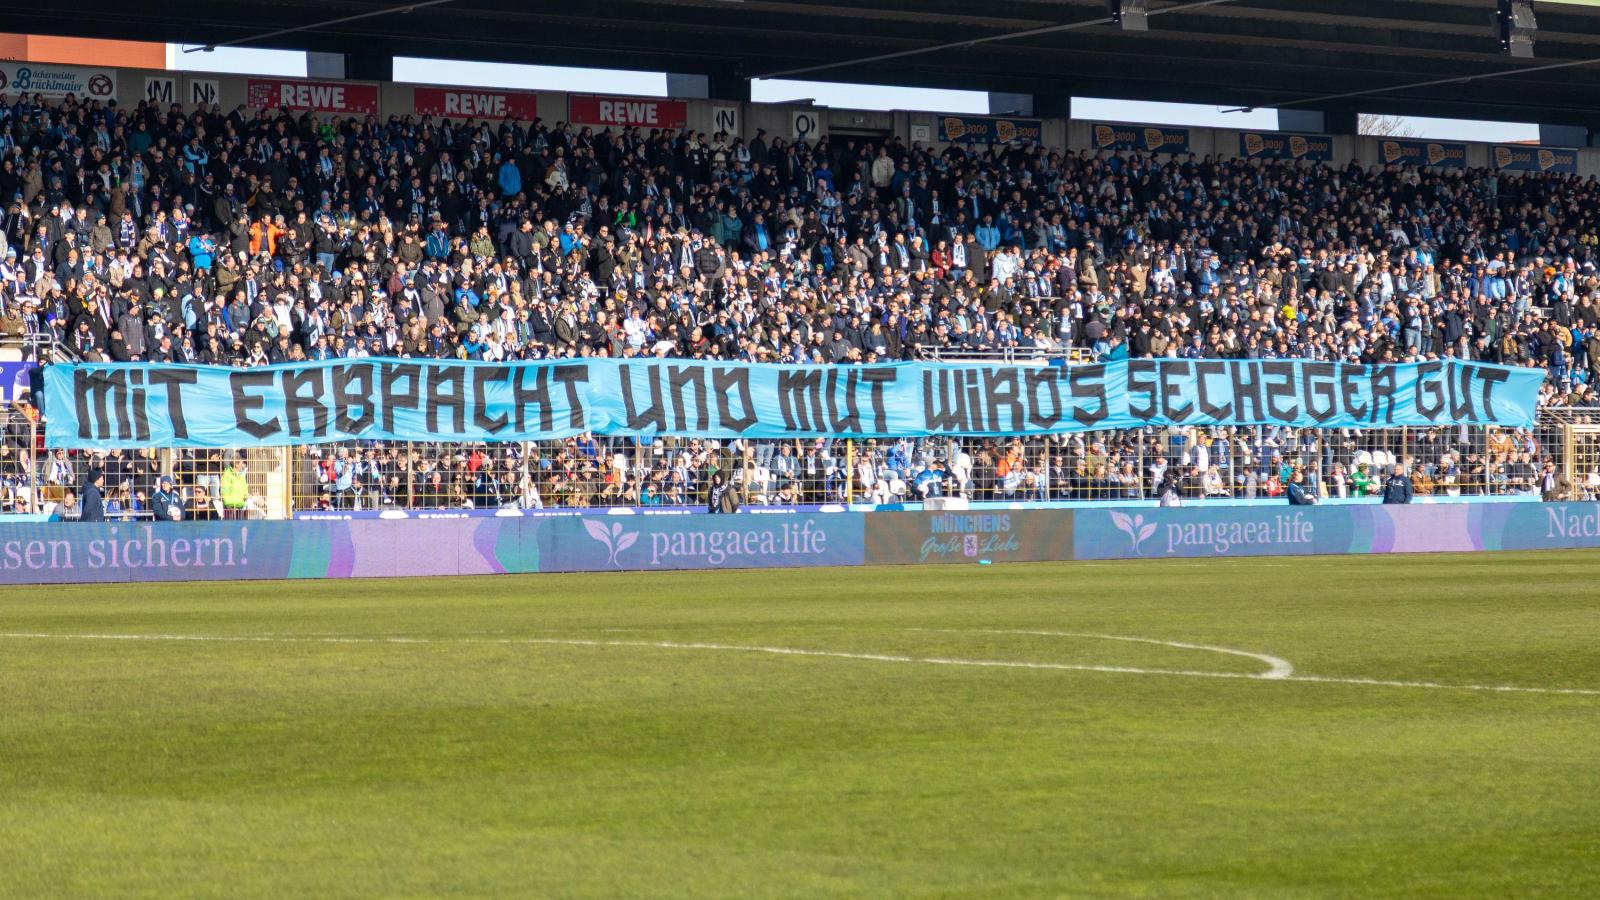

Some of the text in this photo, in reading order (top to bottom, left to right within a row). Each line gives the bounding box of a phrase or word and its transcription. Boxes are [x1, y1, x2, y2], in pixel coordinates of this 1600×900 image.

[153, 80, 172, 102] M
[193, 82, 209, 104] N
[281, 84, 345, 108] REWE
[445, 92, 507, 115] REWE
[600, 101, 658, 124] REWE
[721, 110, 735, 129] N
[230, 363, 590, 439] ERBPACHT
[777, 367, 897, 434] MUT
[1415, 361, 1511, 423] GUT
[931, 512, 1012, 534] MÜNCHENS
[0, 525, 248, 570] sen sichern!
